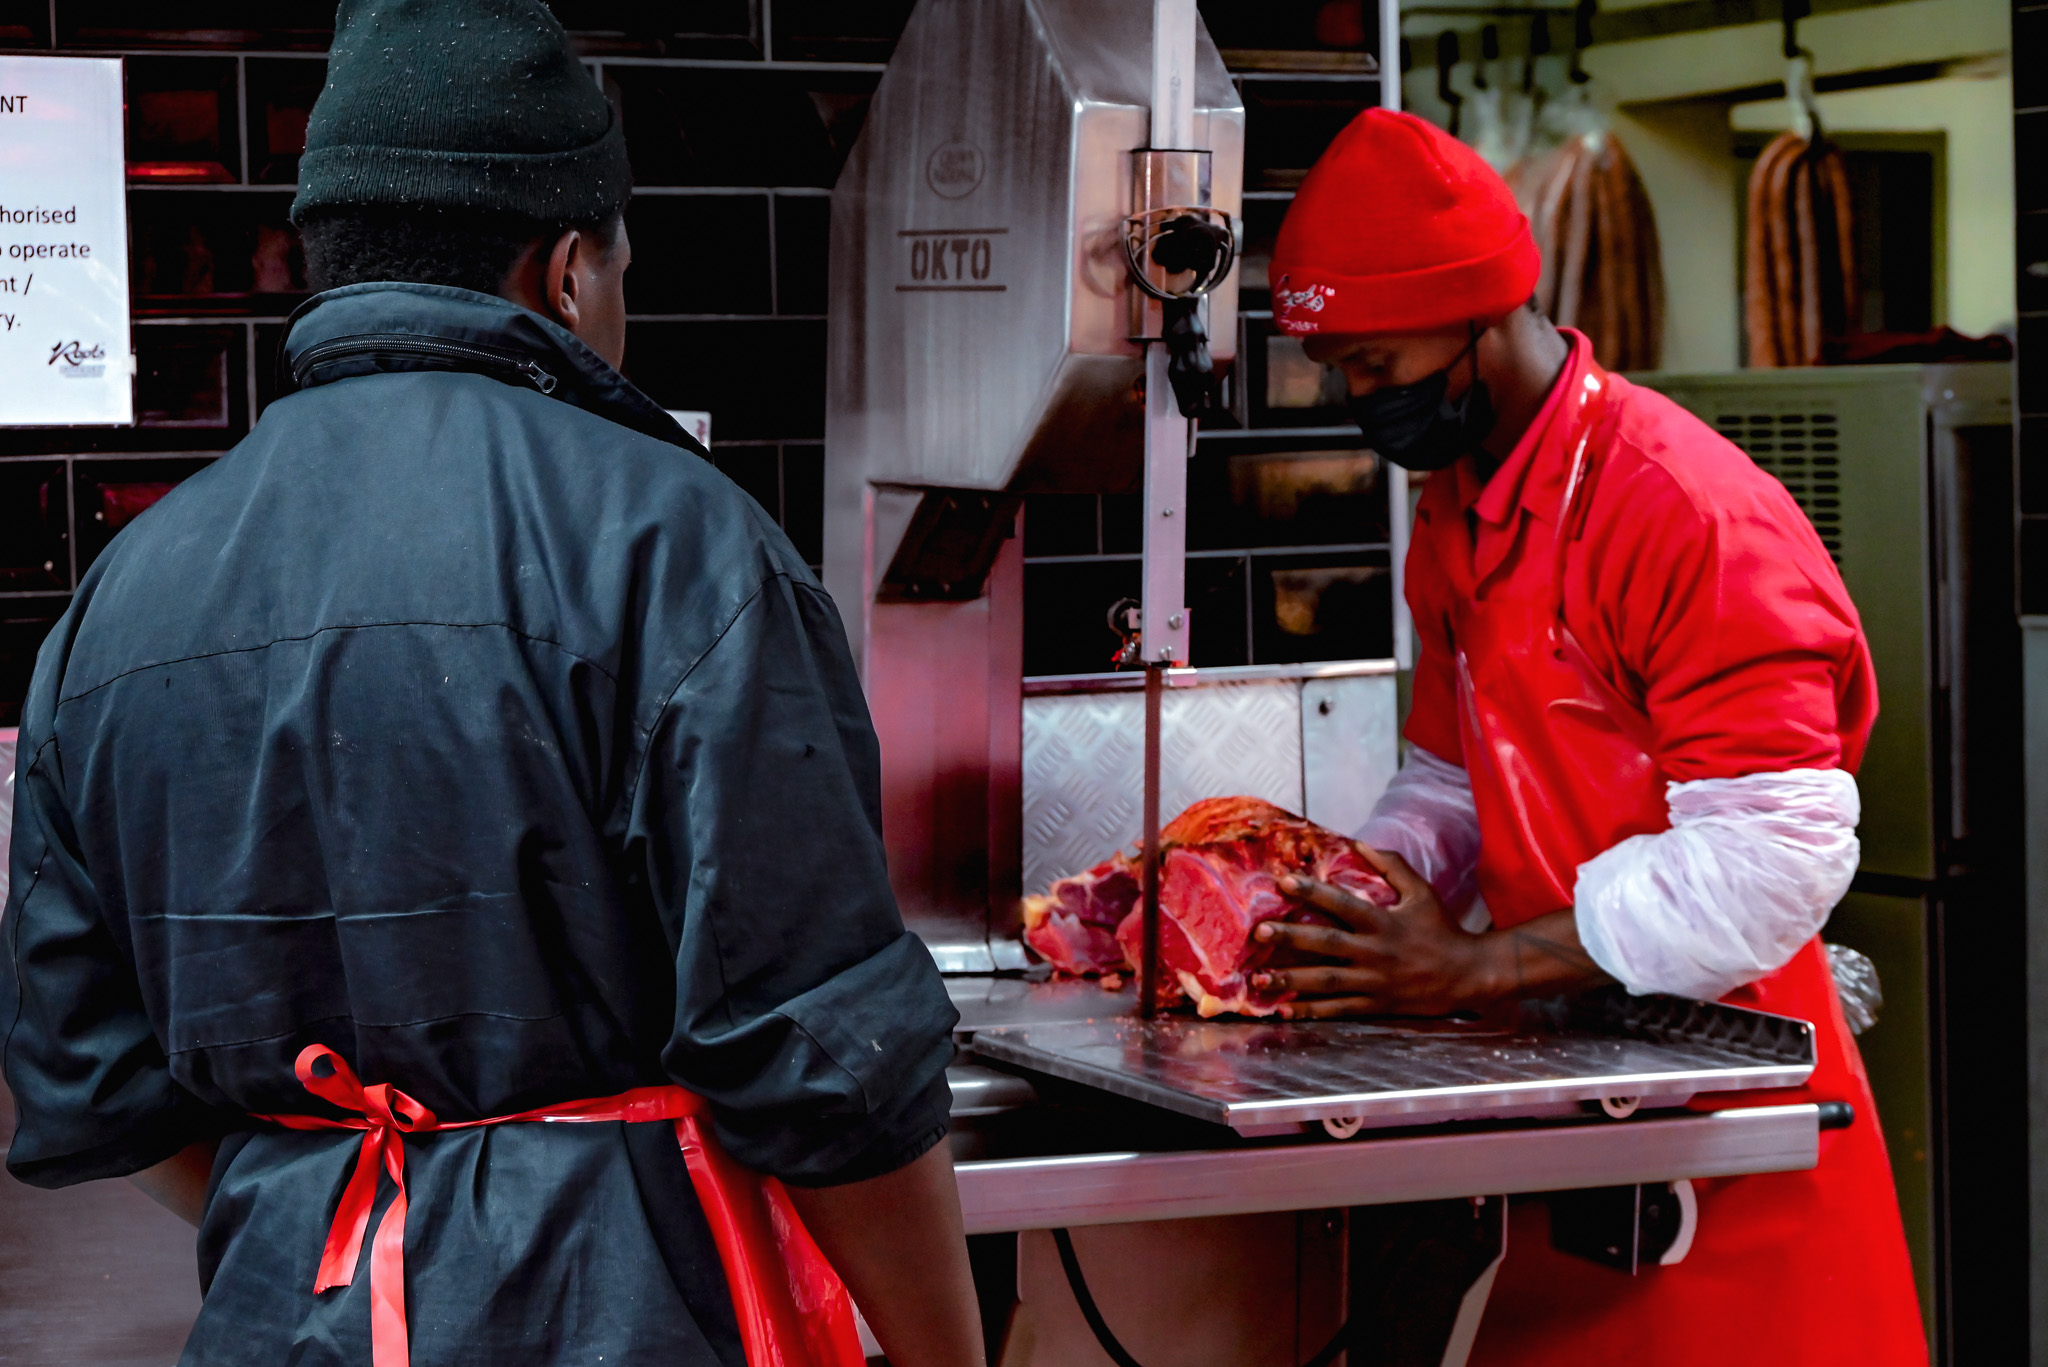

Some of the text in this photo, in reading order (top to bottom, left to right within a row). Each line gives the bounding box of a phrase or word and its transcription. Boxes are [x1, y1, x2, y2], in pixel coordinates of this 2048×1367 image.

[0, 95, 28, 113] NT
[0, 205, 76, 224] horised
[9, 243, 91, 262] operate
[911, 238, 991, 281] OKTO
